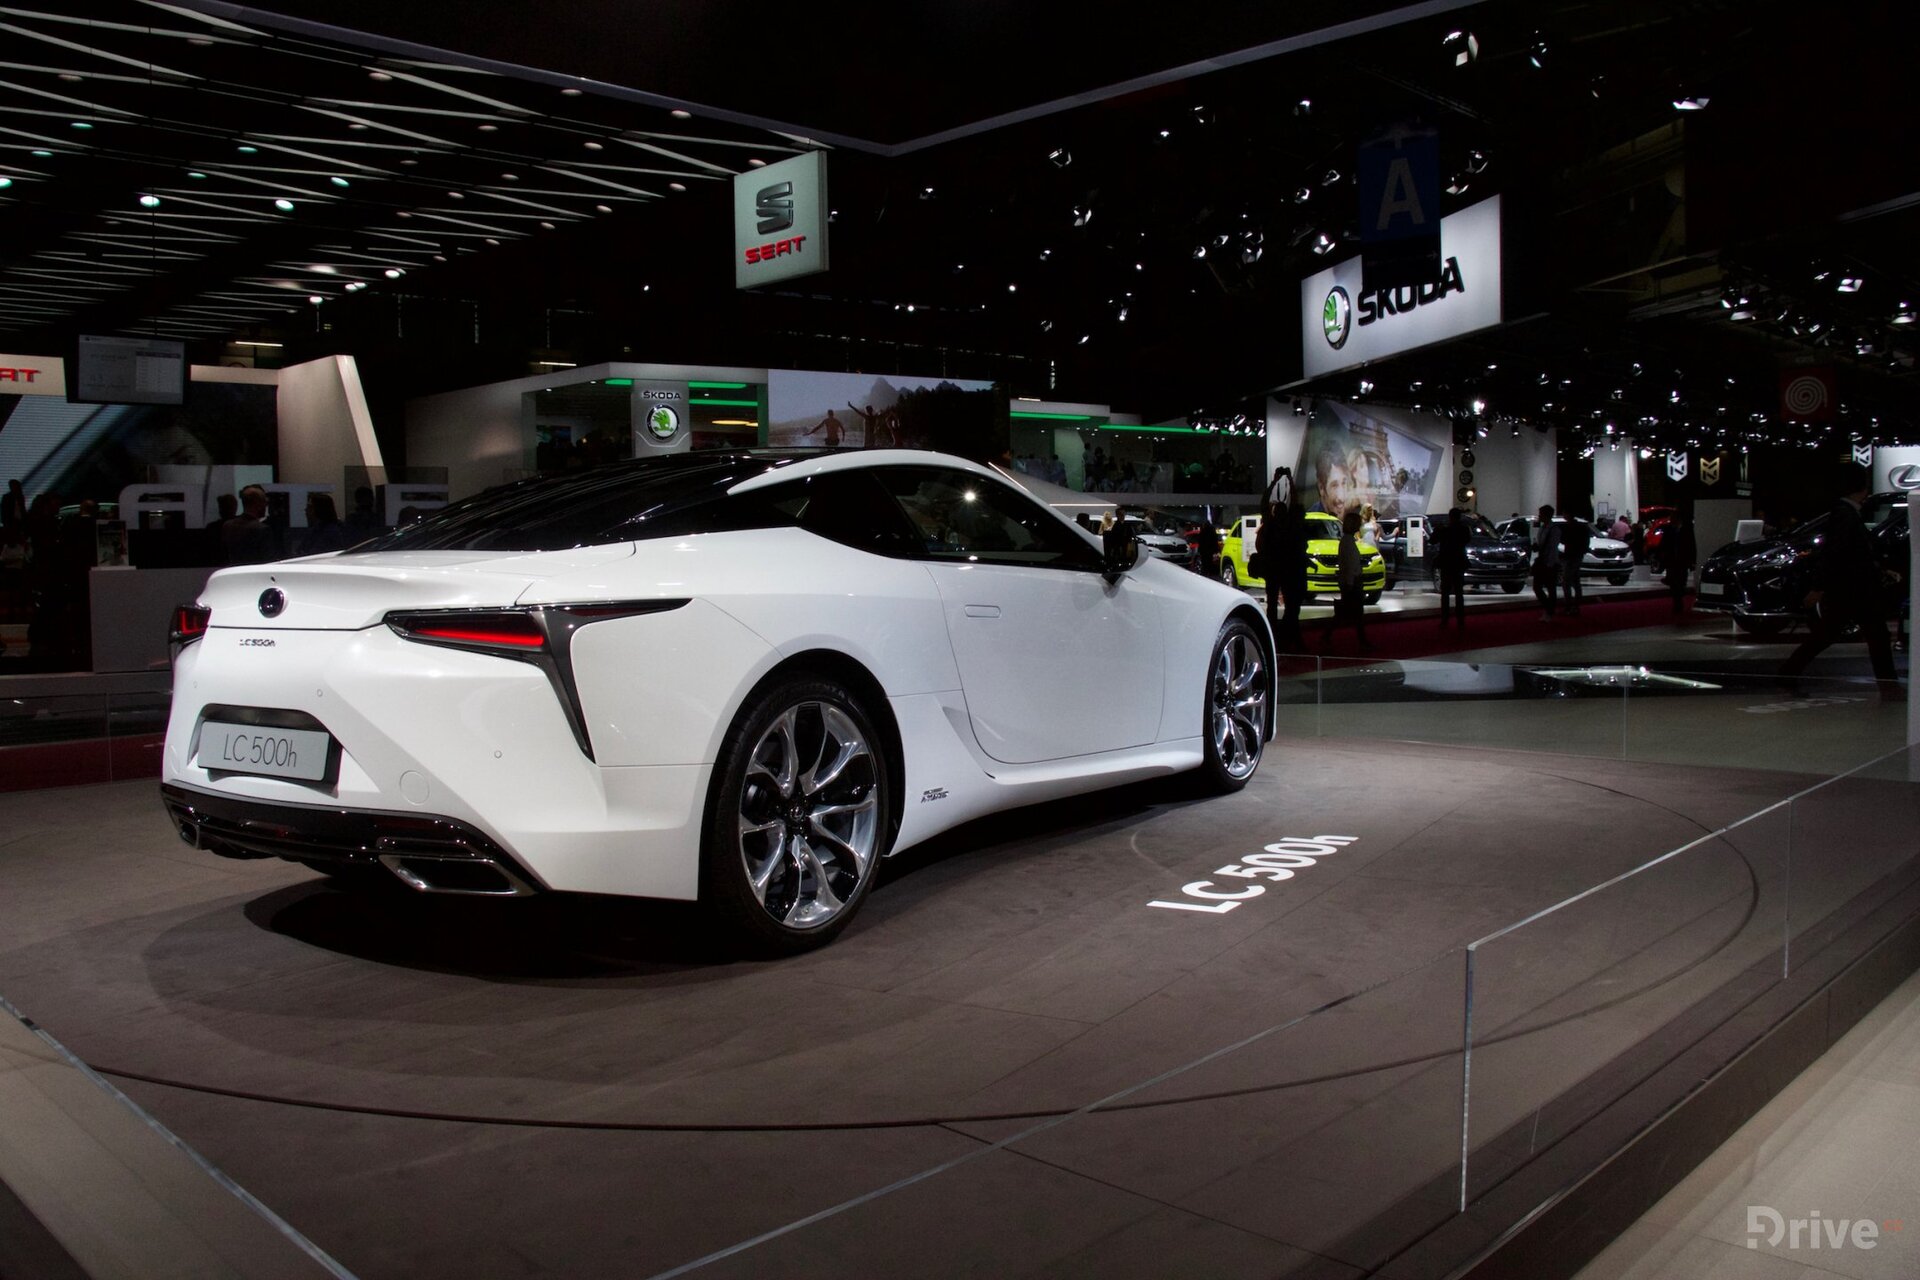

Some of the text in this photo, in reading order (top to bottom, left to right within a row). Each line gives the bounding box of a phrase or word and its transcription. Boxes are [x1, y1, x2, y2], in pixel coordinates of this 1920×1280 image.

[1376, 157, 1425, 230] A
[745, 236, 806, 264] SEAT
[223, 733, 297, 768] LC 500h
[1146, 835, 1359, 914] LC 500h
